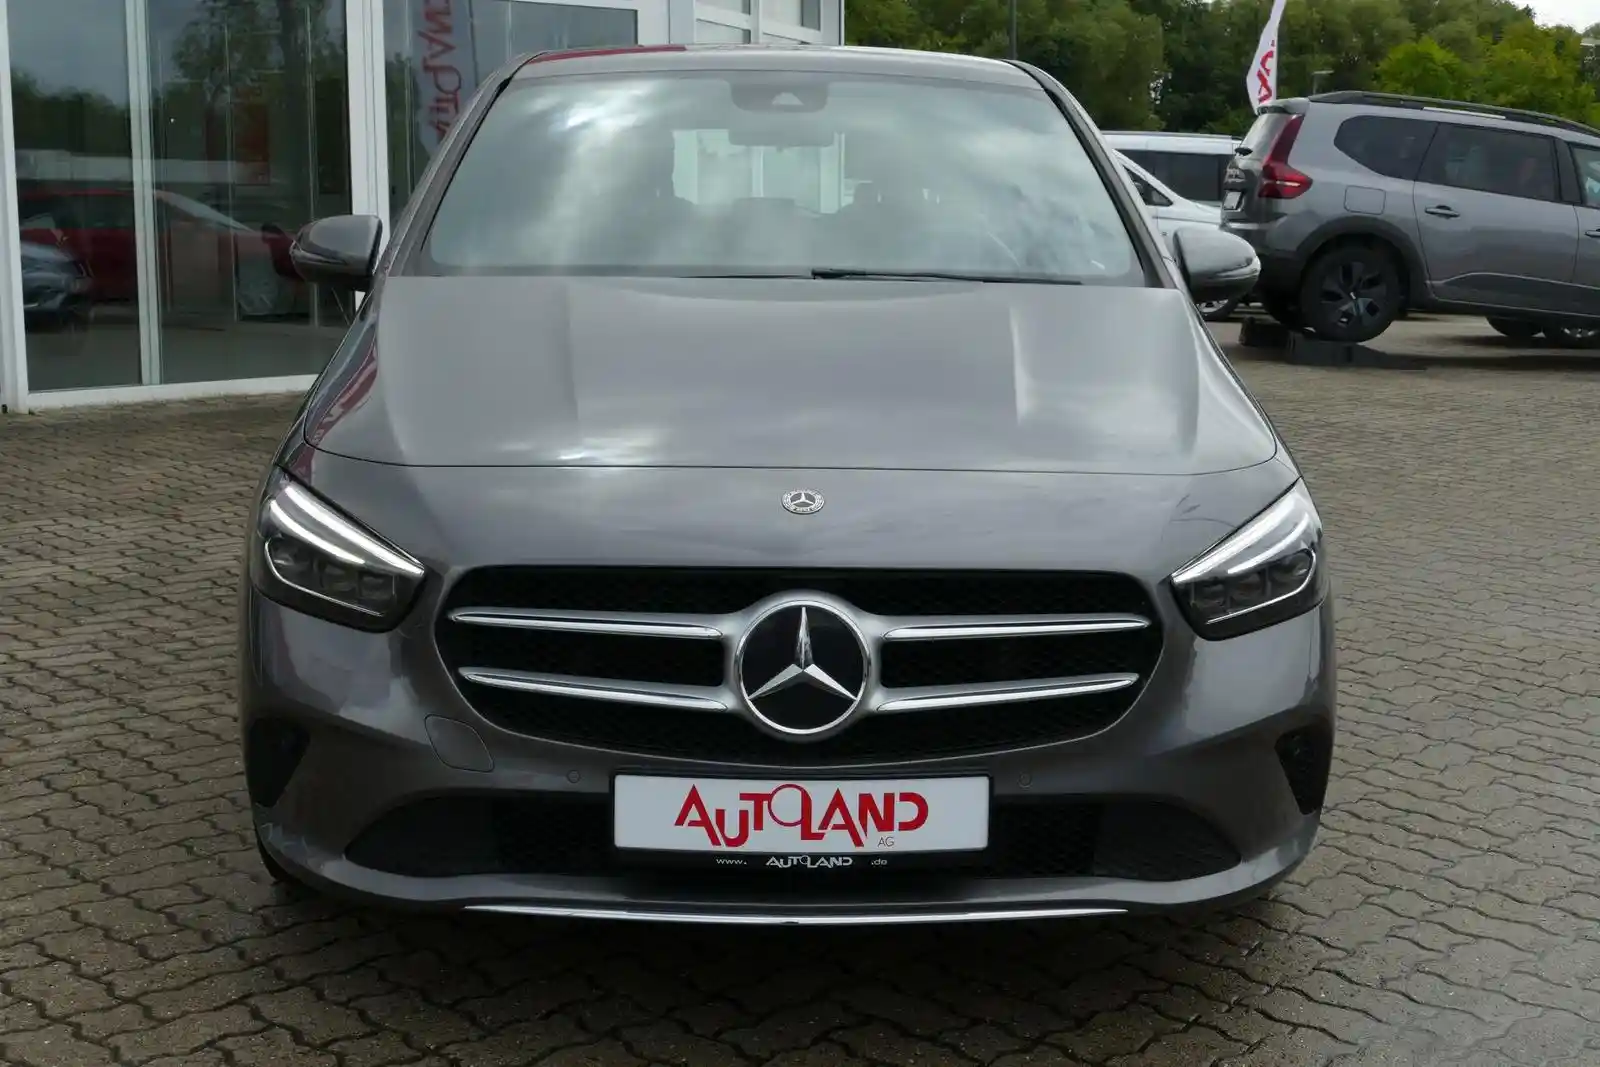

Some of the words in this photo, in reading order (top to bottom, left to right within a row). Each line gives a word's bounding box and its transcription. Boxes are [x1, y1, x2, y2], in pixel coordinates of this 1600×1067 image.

[674, 783, 929, 848] AUTOLAND
[877, 836, 895, 848] AG
[715, 857, 747, 865] www.
[765, 854, 853, 868] AUTOLAND
[871, 856, 888, 866] .de
